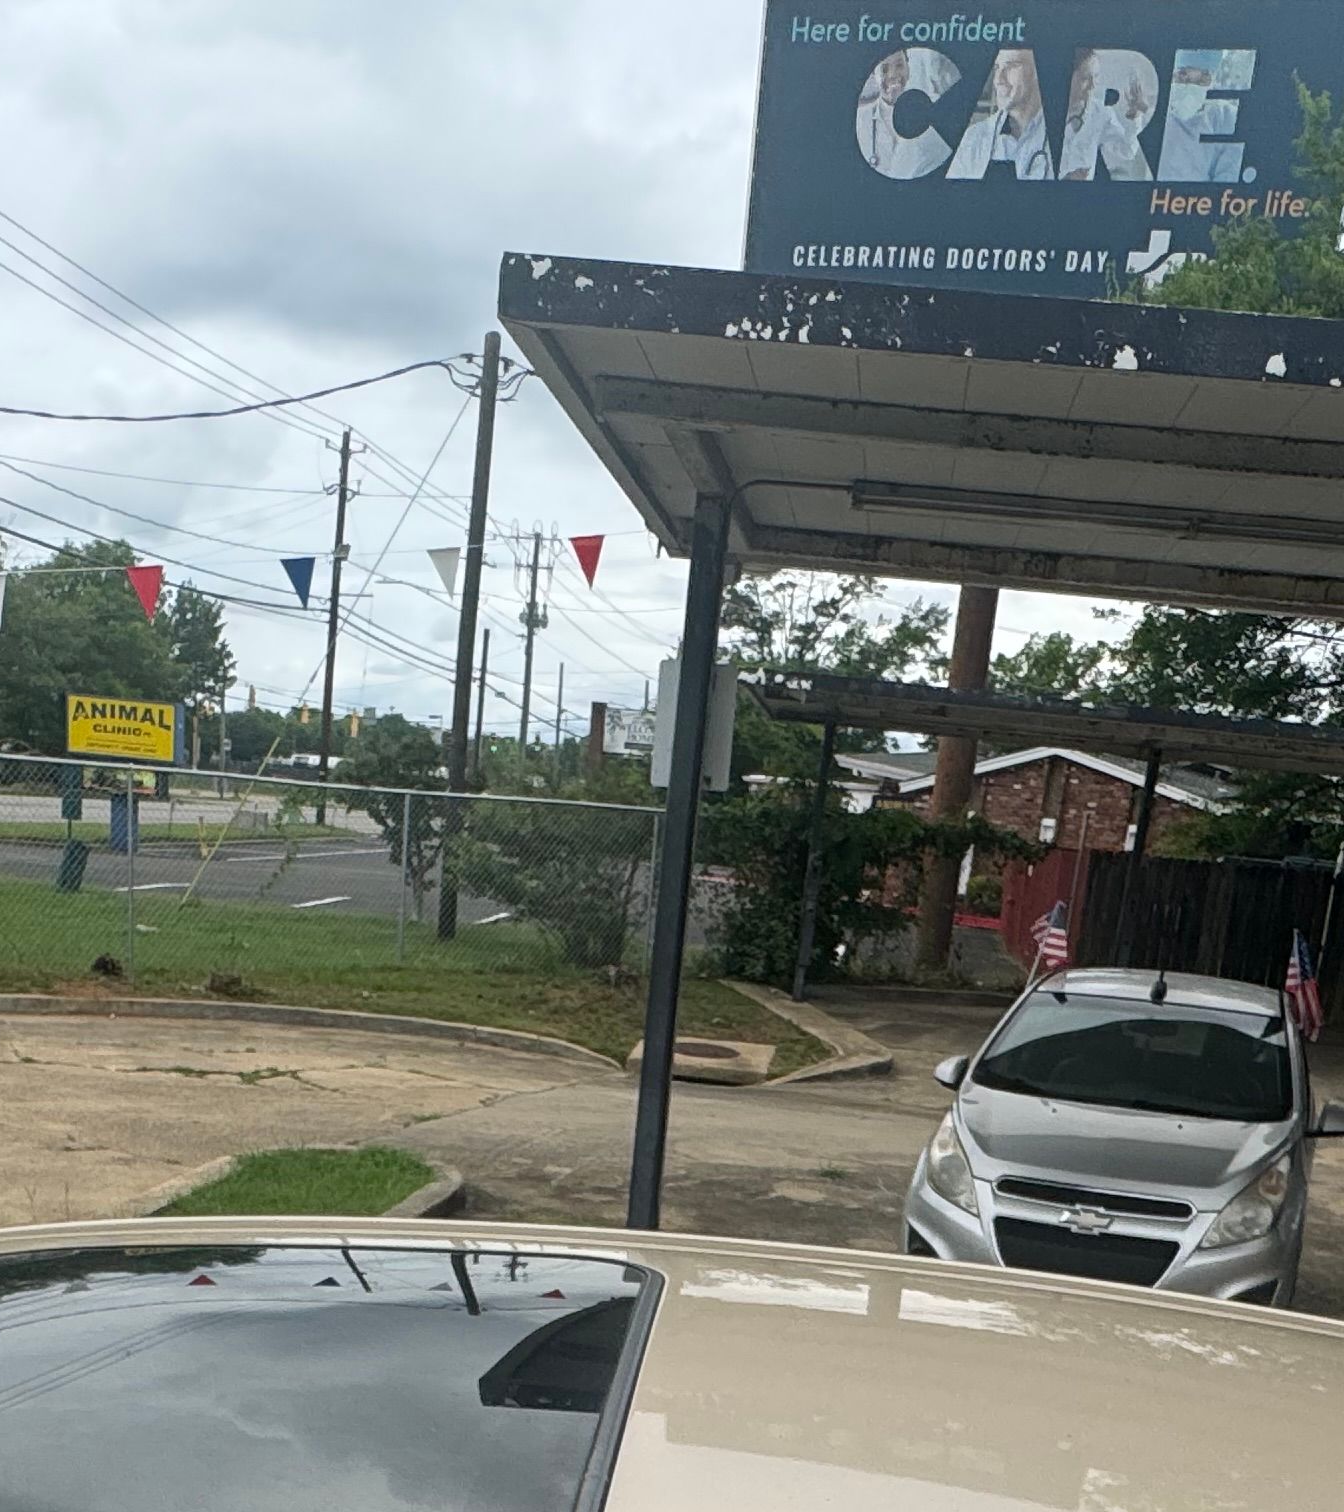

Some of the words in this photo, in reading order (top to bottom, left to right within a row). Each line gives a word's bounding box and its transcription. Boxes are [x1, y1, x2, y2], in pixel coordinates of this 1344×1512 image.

[791, 16, 850, 43] Here
[858, 14, 894, 42] for
[900, 14, 1025, 43] confident
[856, 47, 1257, 183] CARE.
[1150, 188, 1212, 216] Here
[1220, 189, 1258, 217] for
[1264, 189, 1311, 218] life.
[792, 245, 936, 269] CELEBRATING
[1064, 250, 1108, 274] DAY
[72, 700, 172, 731] ANIMAL
[92, 723, 143, 737] CLINIC
